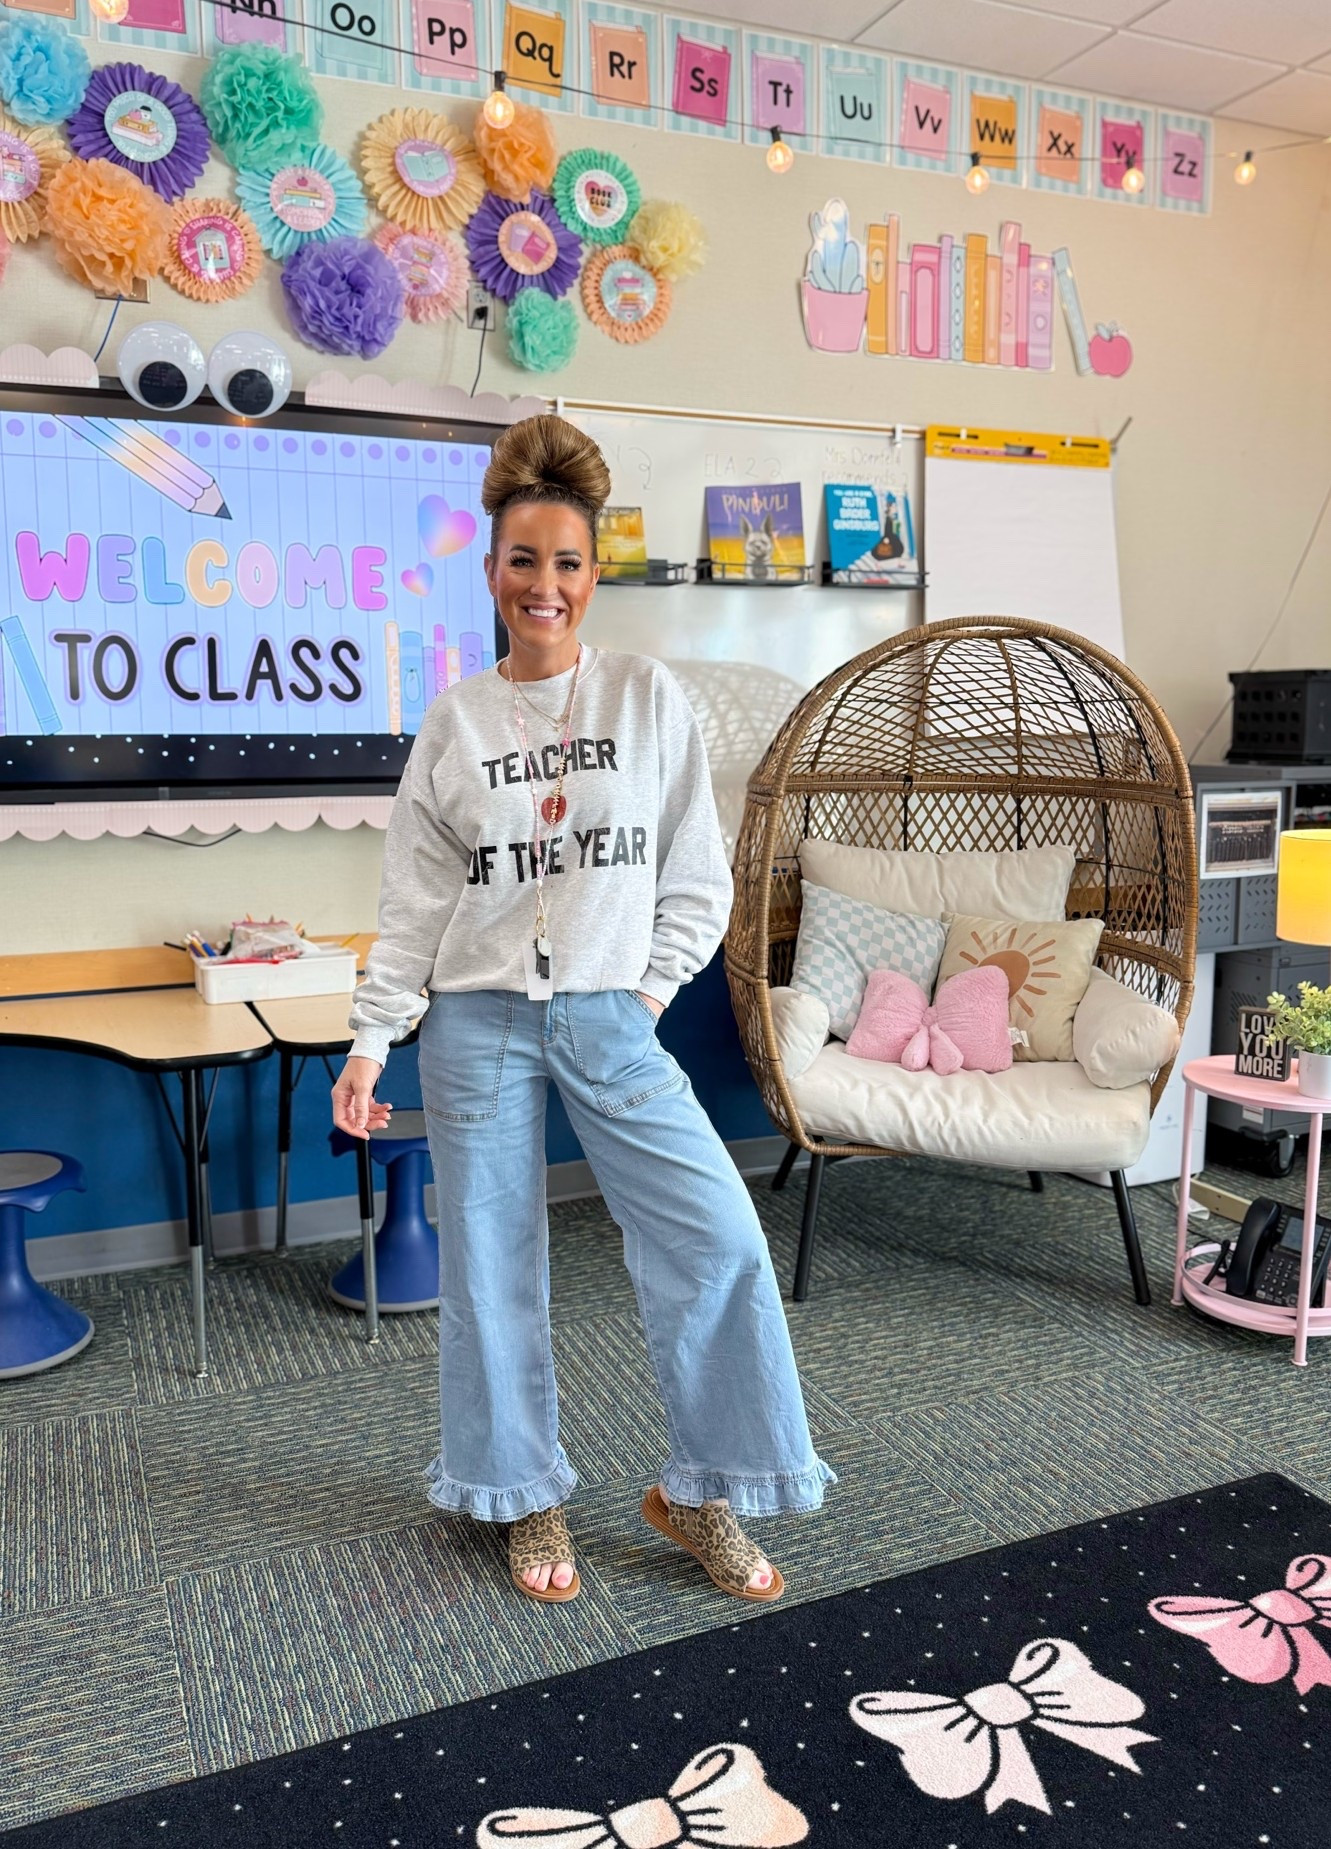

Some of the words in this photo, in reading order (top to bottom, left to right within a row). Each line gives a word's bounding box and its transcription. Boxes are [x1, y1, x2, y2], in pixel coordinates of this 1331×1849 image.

[330, 2, 377, 37] Oo
[427, 17, 468, 56] Pp
[514, 30, 561, 79] Qq
[608, 50, 638, 80] Rr
[688, 67, 719, 98] Ss
[767, 80, 794, 108] Tt
[839, 95, 873, 121] Uu
[914, 105, 942, 135] Vv
[976, 119, 1015, 146] Ww
[1047, 130, 1076, 158] Xx
[1172, 152, 1198, 178] Zz
[722, 493, 789, 522] PINDULI
[15, 530, 388, 611] WELCOME
[54, 633, 137, 701] TO
[165, 636, 362, 702] CLASS
[482, 738, 619, 790] TEACHER
[508, 836, 565, 883] THE
[573, 826, 647, 869] YEAR
[1240, 1013, 1277, 1035] LOV
[1240, 1032, 1284, 1060] YOU
[1238, 1054, 1283, 1079] MORE
